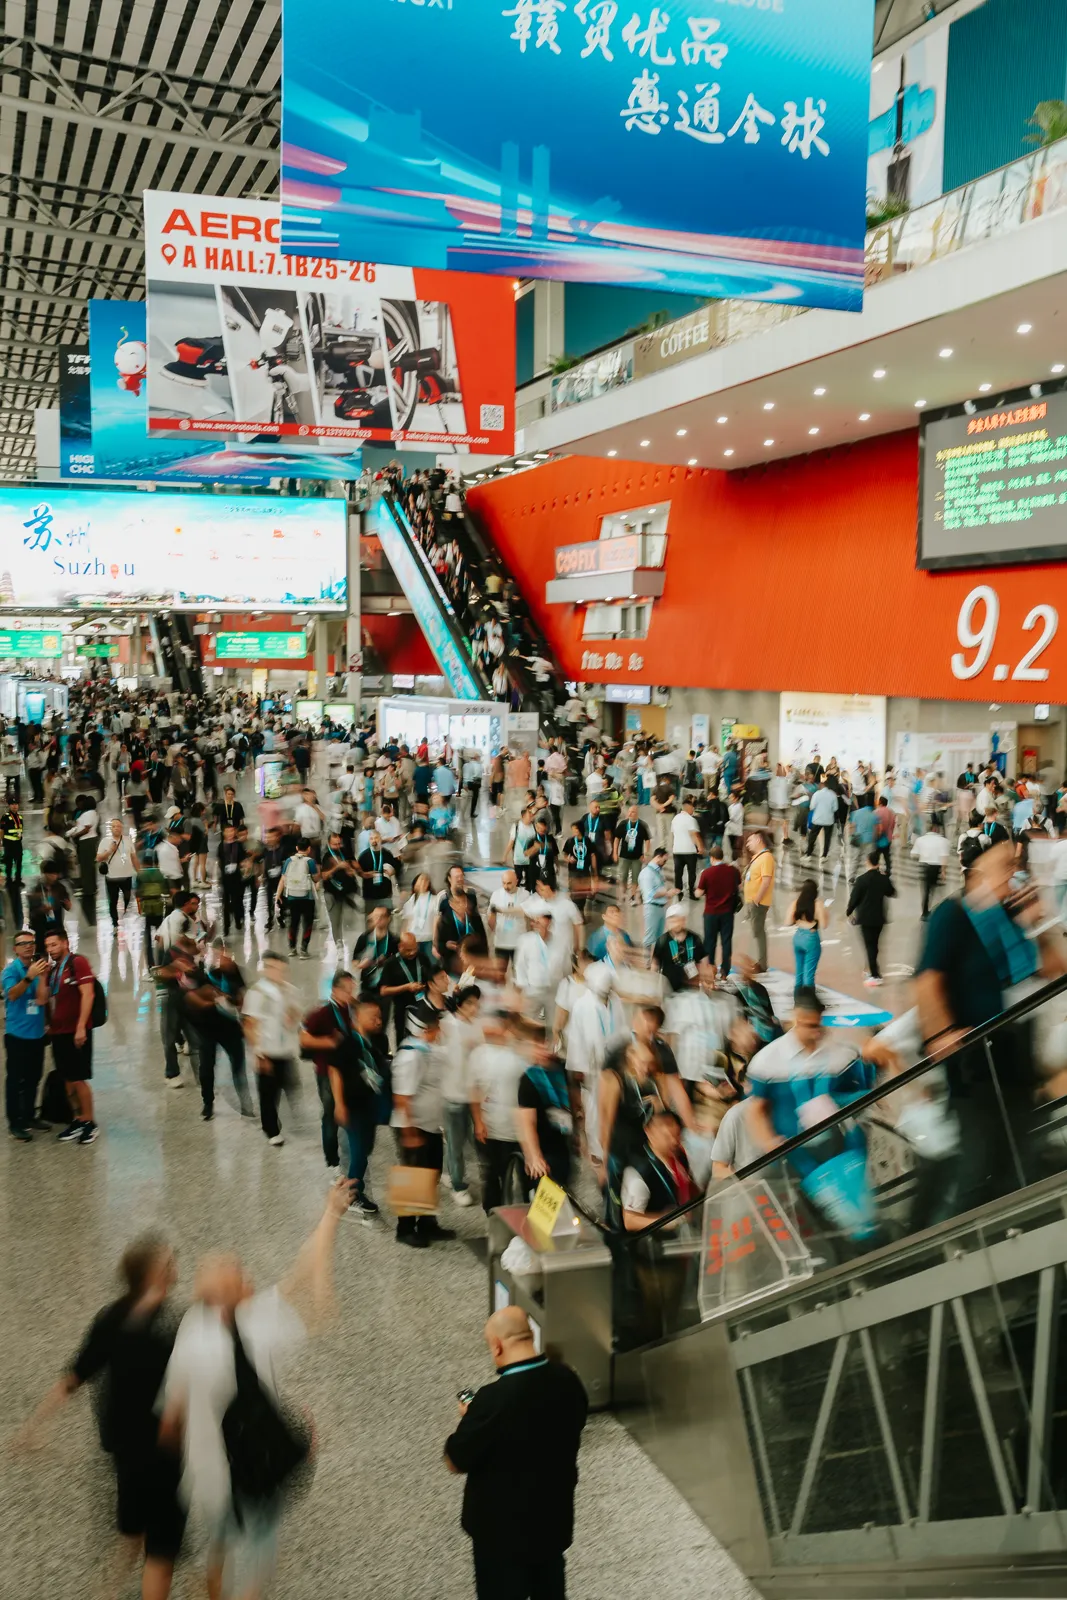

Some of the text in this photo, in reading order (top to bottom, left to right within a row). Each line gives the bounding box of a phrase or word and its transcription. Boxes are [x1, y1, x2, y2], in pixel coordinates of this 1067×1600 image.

[620, 68, 830, 160] 惠通全球
[183, 245, 197, 268] A
[660, 320, 710, 359] COFFEE
[192, 421, 280, 433] www.aeroprotools.com
[23, 504, 91, 553] 苏州
[951, 584, 1059, 682] 9.2
